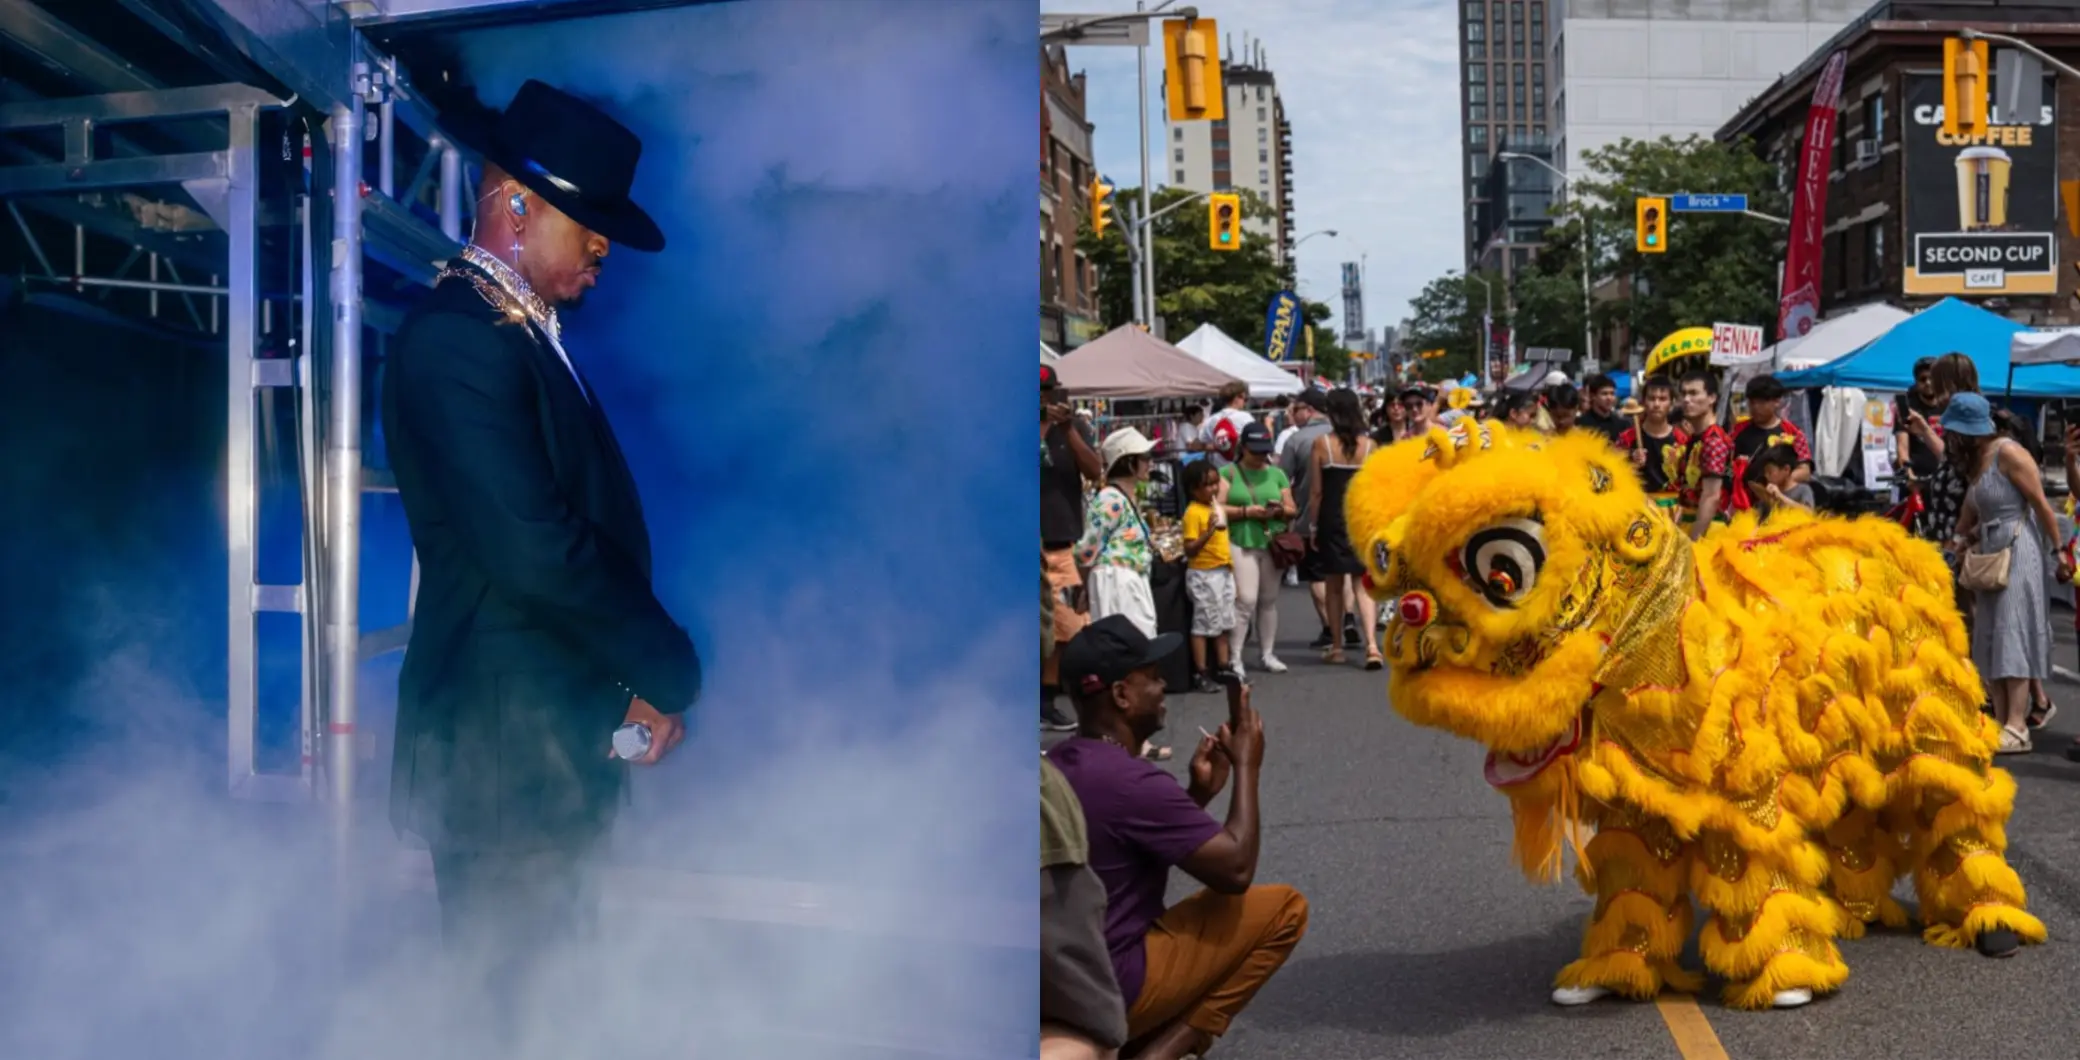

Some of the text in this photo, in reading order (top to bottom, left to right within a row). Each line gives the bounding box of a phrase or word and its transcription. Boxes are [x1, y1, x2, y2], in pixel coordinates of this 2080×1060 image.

[1688, 195, 1719, 207] Brock
[1925, 245, 2044, 263] SECOND CUP
[1268, 295, 1295, 361] SPAM
[1713, 325, 1760, 358] HENNA
